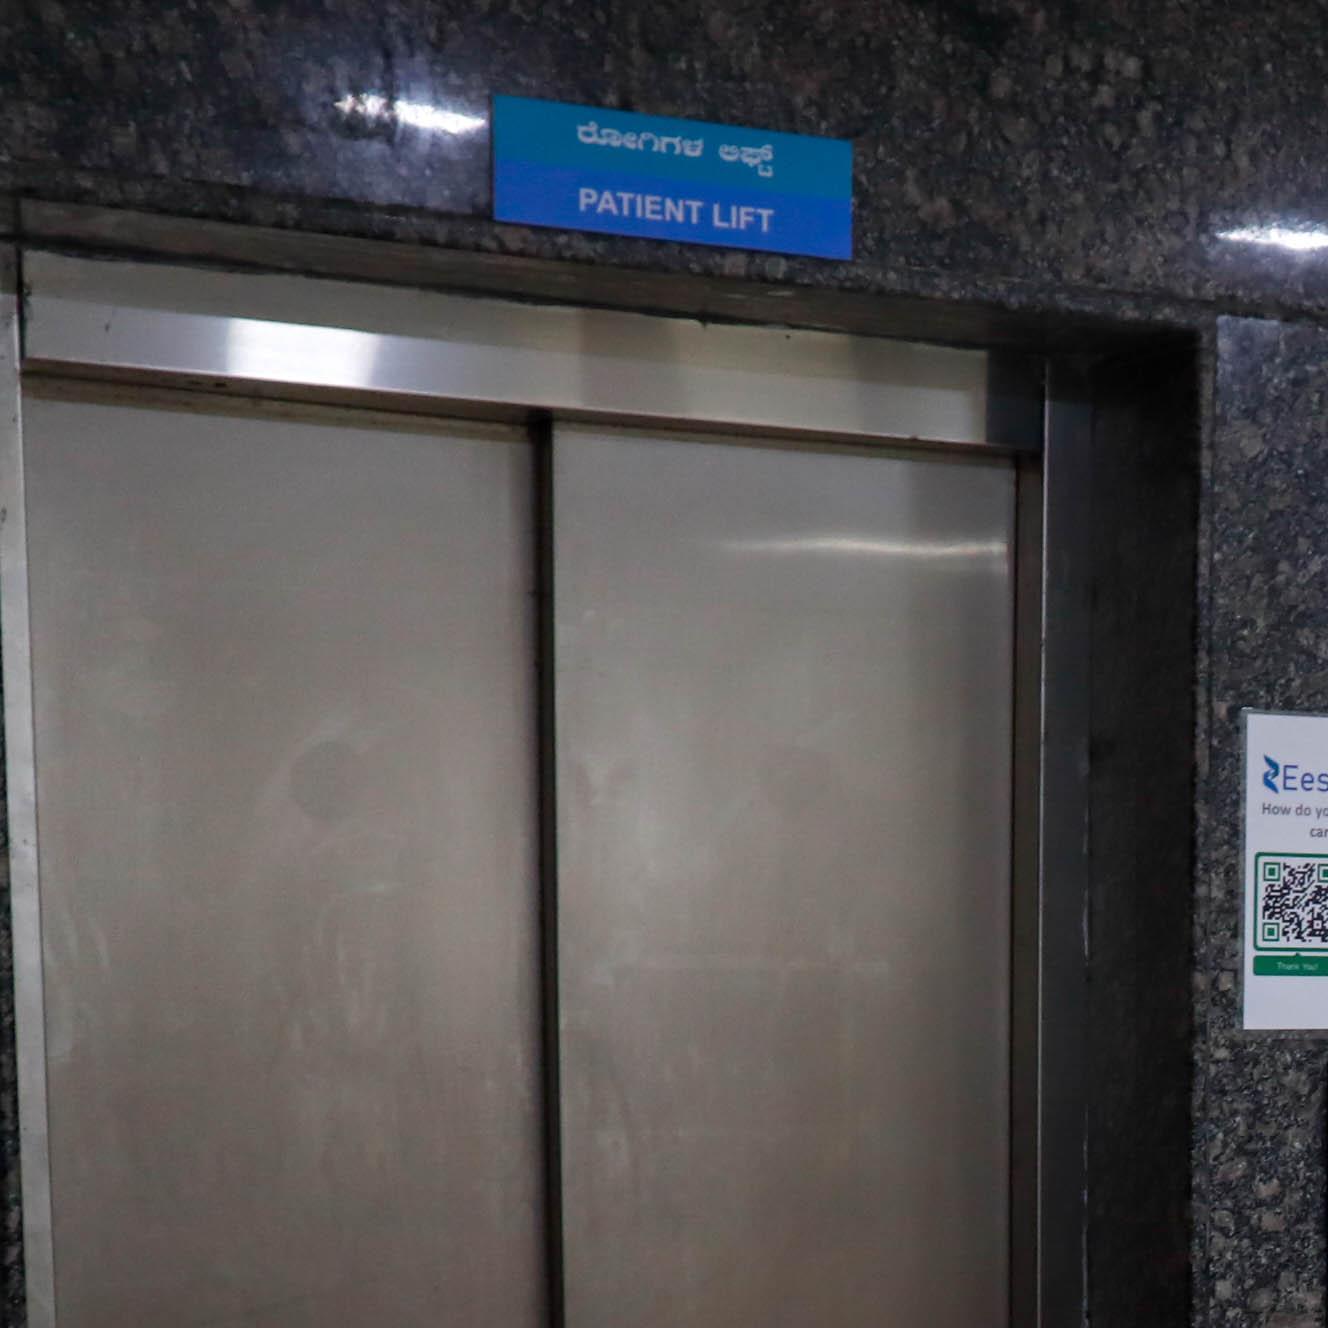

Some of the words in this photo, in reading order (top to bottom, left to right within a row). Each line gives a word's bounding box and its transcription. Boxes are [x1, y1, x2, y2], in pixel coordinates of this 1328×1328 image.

[576, 120, 705, 158] ರೋಗಿಗಳ
[578, 187, 704, 224] PATIENT
[713, 203, 775, 232] LIFT
[1262, 802, 1293, 816] How
[1295, 803, 1312, 817] do
